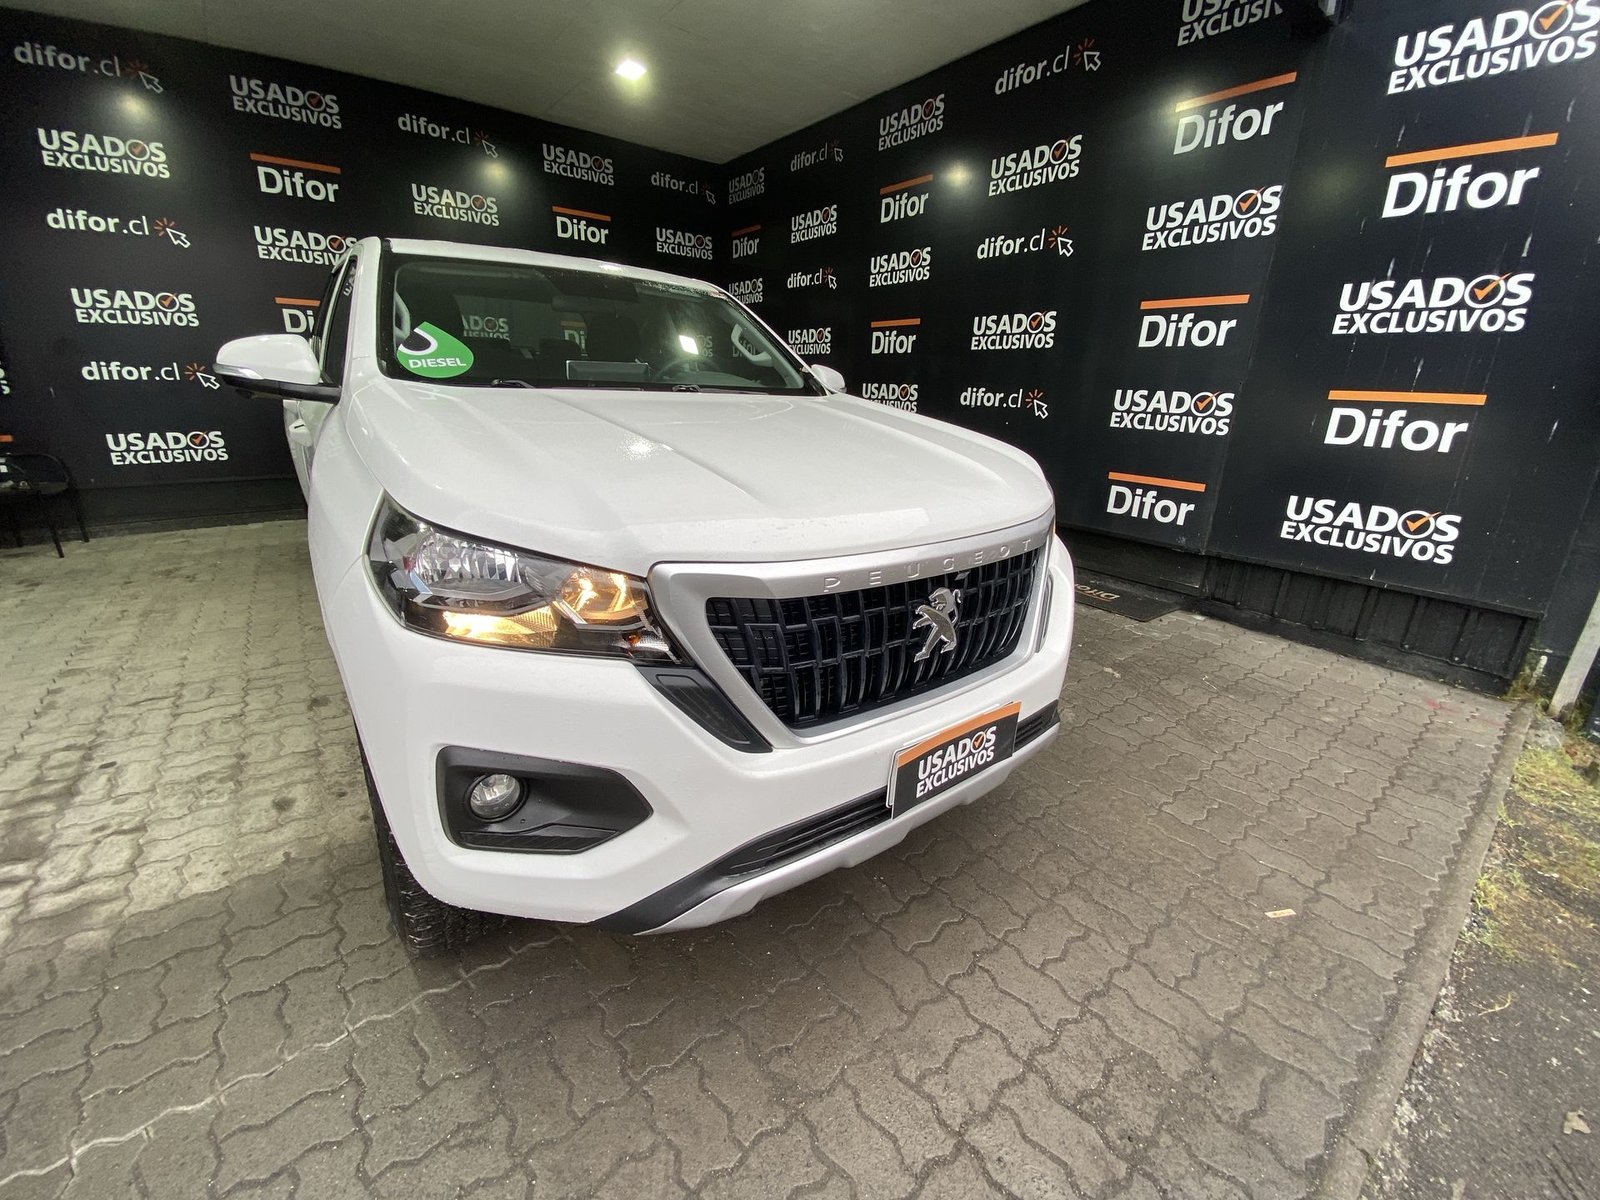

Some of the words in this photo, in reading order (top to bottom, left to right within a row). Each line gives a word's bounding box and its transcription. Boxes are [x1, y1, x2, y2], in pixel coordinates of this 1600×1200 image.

[1394, 0, 1600, 68] USADOS
[14, 42, 121, 77] difor.cl
[995, 45, 1070, 95] difor.cl
[1387, 30, 1598, 95] EXCLUSIVOS
[229, 75, 340, 114] USADOS
[233, 96, 342, 129] EXCLUSIVOS
[879, 94, 945, 136] USADOS
[398, 113, 470, 145] difor.cl
[878, 115, 943, 151] EXCLUSIVOS
[1174, 102, 1284, 155] Difor
[37, 128, 167, 163] USADOS
[542, 143, 614, 174] USADOS
[790, 142, 828, 172] difor.cl
[991, 134, 1083, 179] USADOS
[41, 150, 170, 179] EXCLUSIVOS
[543, 160, 614, 186] EXCLUSIVOS
[988, 159, 1080, 197] EXCLUSIVOS
[257, 166, 339, 202] Difor
[651, 171, 699, 195] difor.cl
[729, 167, 765, 194] USADOS
[1381, 164, 1540, 218] Difor
[411, 183, 498, 214] USADOS
[880, 192, 929, 224] Difor
[1146, 185, 1284, 231] USADOS
[46, 208, 149, 236] difor.cl
[413, 201, 500, 227] EXCLUSIVOS
[791, 204, 838, 231] USADOS
[556, 216, 609, 245] Difor
[656, 227, 713, 250] USADOS
[791, 221, 837, 244] EXCLUSIVOS
[977, 228, 1045, 259] difor.cl
[1142, 215, 1278, 251] EXCLUSIVOS
[257, 244, 340, 266] EXCLUSIV
[656, 240, 713, 260] EXCLUSIVOS
[732, 236, 760, 259] Difor
[870, 247, 931, 274] USADOS
[787, 268, 822, 289] difor.cl
[869, 266, 930, 287] EXCLUSIVOS
[70, 287, 196, 312] USADOS
[1340, 273, 1535, 312] USADOS
[75, 308, 200, 327] EXCLUSIVOS
[973, 310, 1057, 336] USADOS
[1138, 313, 1237, 348] Difor
[1332, 308, 1527, 335] EXCLUSIVOS
[788, 327, 832, 344] USADOS
[871, 331, 916, 354] Difor
[971, 332, 1054, 350] EXCLUSIVOS
[81, 361, 181, 381] difor.cl
[408, 357, 467, 369] DIESEL
[862, 383, 919, 401] USADOS
[960, 387, 1022, 408] difor.cl
[1113, 389, 1235, 418] USADOS
[1110, 412, 1230, 436] EXCLUSIVOS
[1324, 407, 1468, 453] Difor
[105, 430, 225, 452] USADOS
[110, 448, 229, 466] EXCLUSIVOS
[1107, 485, 1196, 526] Difor
[1286, 495, 1462, 542] USADOS
[1280, 521, 1454, 565] EXCLUSIVOS
[823, 539, 1032, 593] PEUGEOT
[918, 725, 997, 780] USADOS
[916, 747, 995, 799] EXCLUSIVOS
